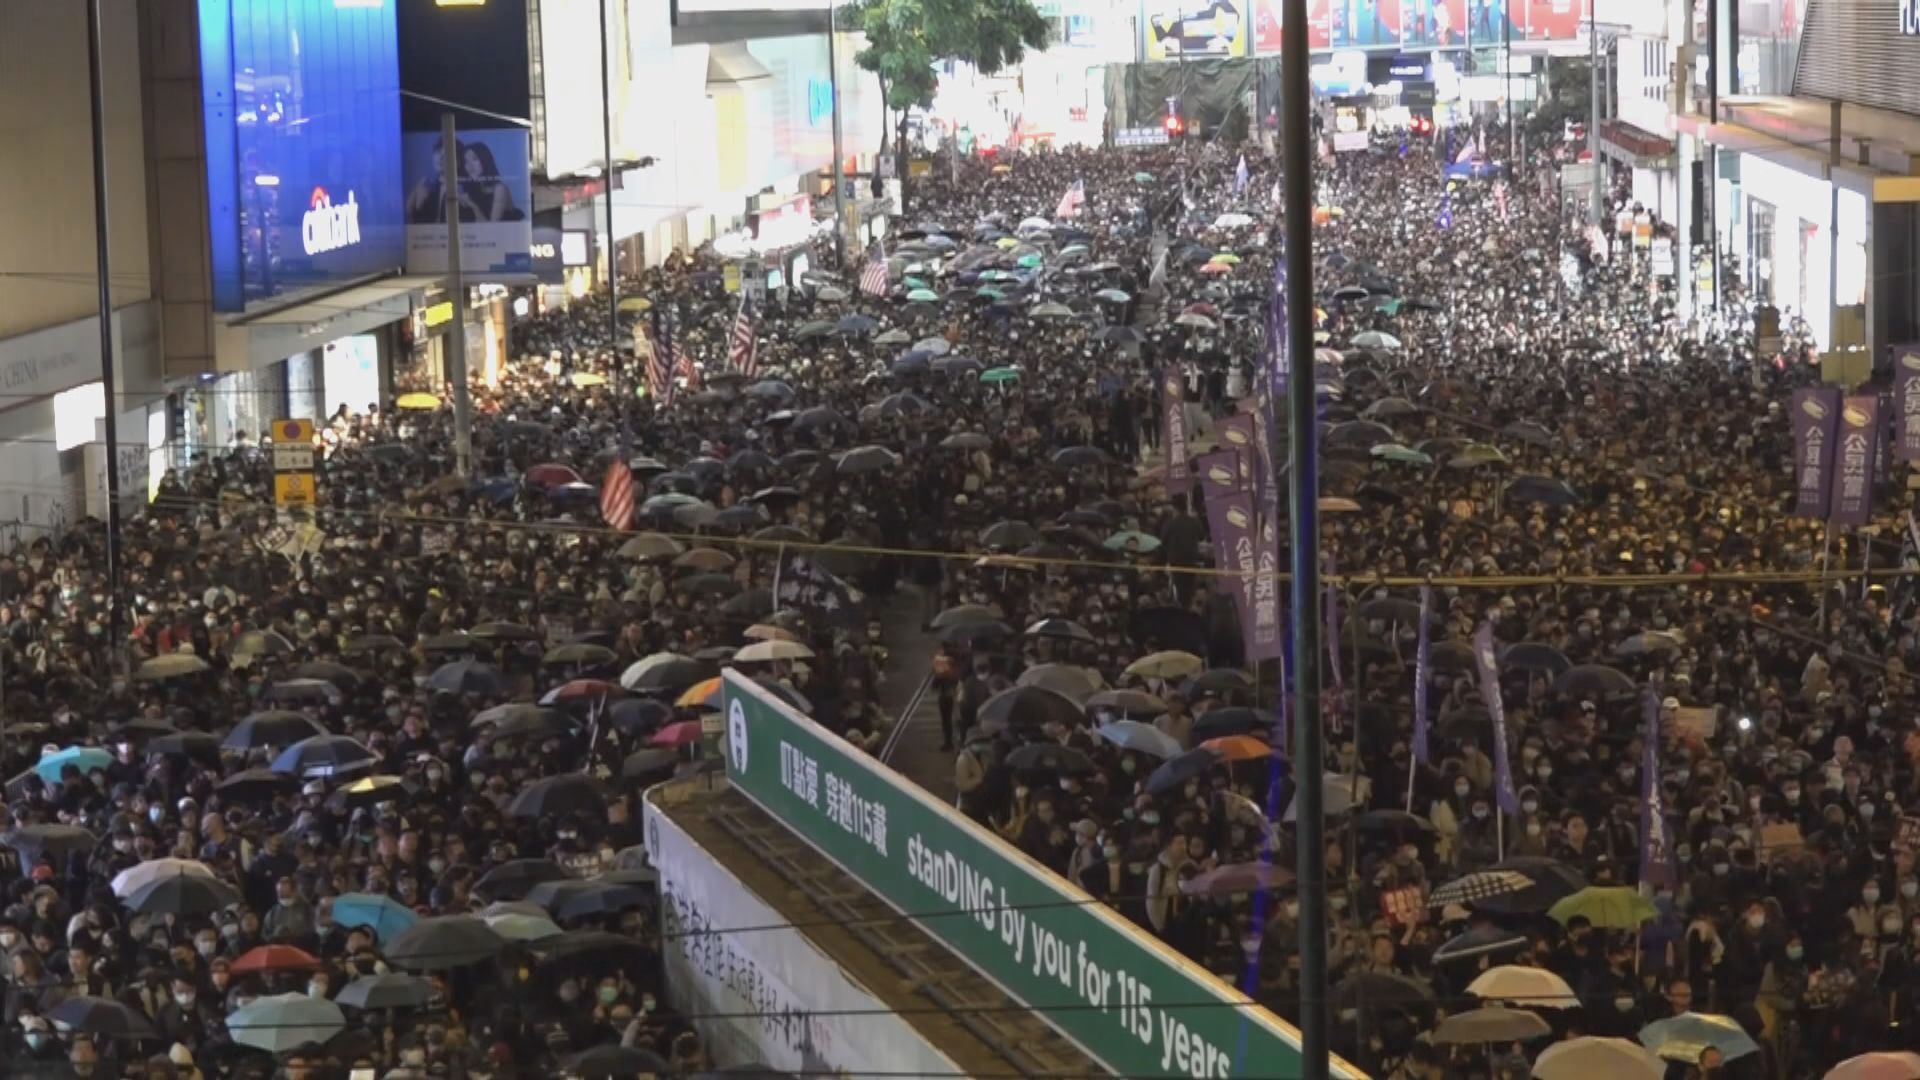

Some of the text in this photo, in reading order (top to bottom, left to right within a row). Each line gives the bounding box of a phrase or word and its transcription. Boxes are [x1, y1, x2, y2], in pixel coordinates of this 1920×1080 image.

[907, 832, 1231, 1079] stanDING by you for 115 years
